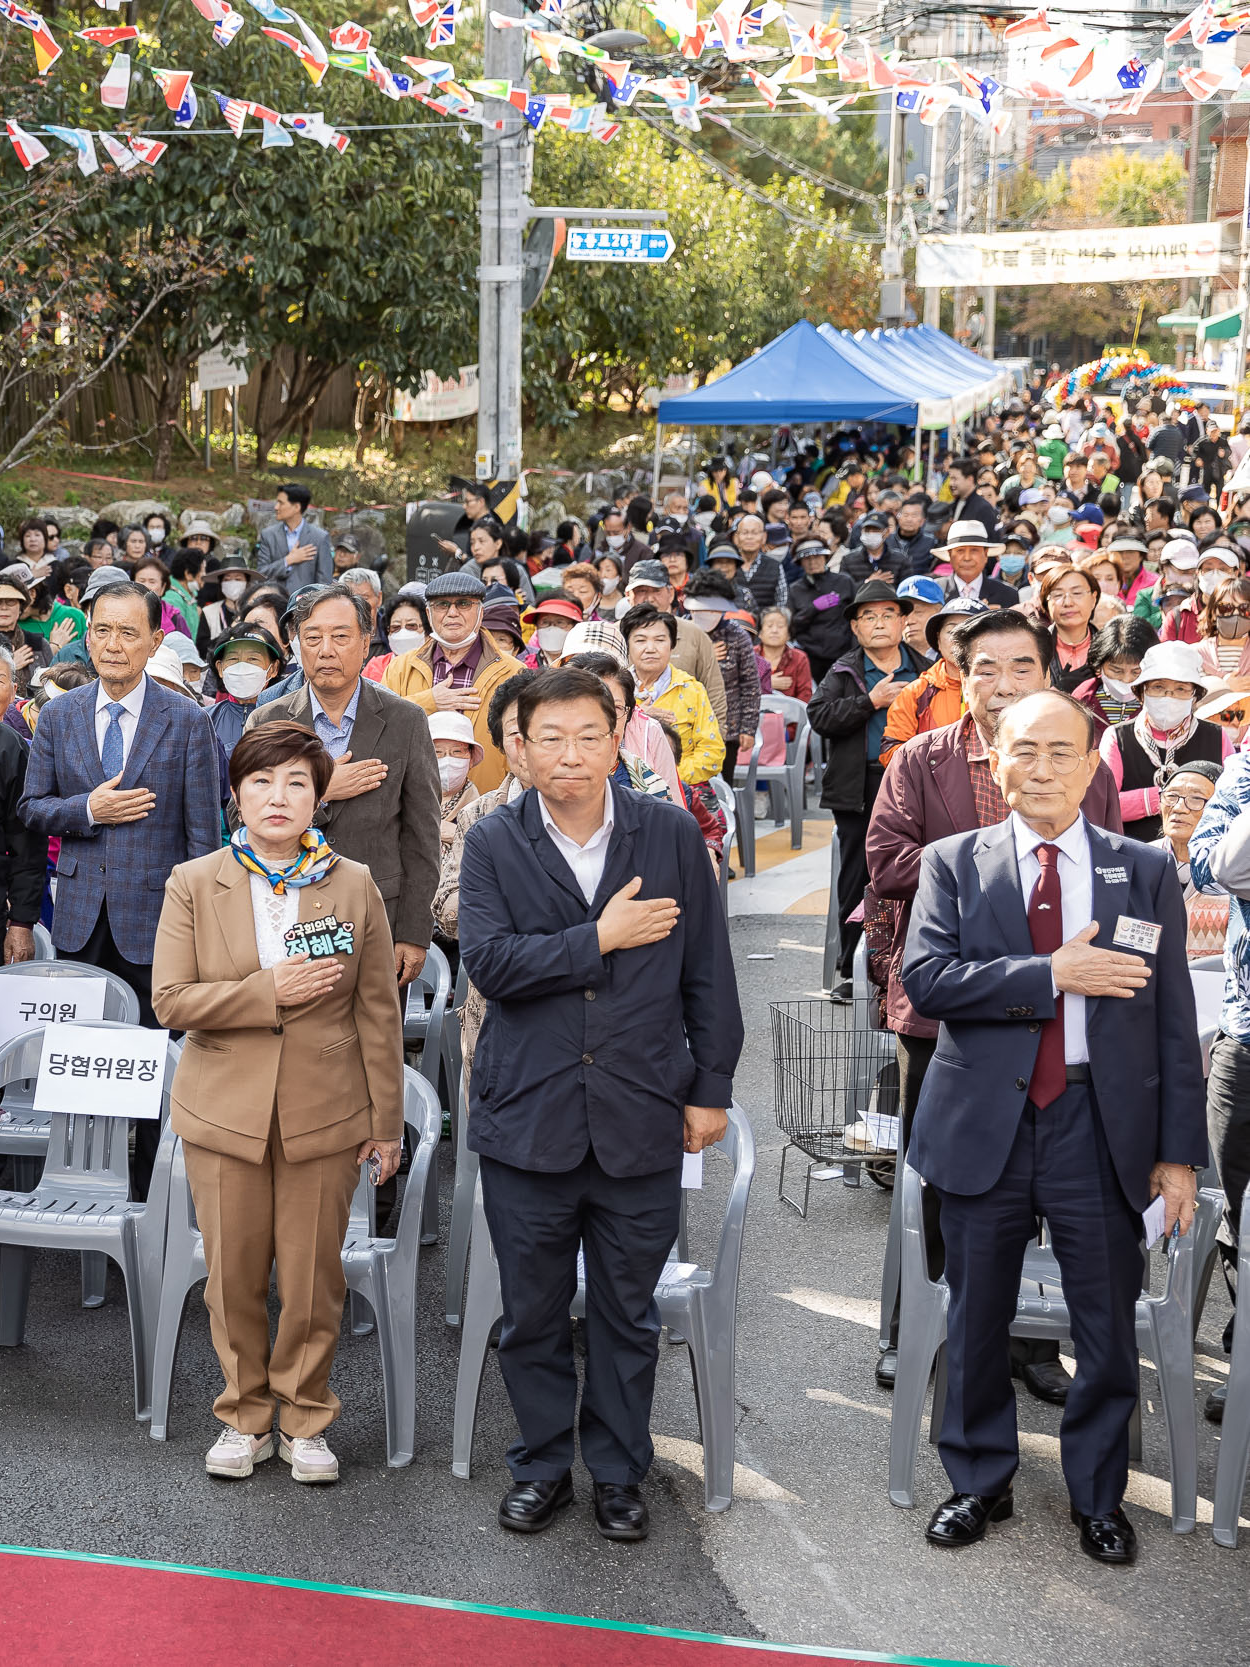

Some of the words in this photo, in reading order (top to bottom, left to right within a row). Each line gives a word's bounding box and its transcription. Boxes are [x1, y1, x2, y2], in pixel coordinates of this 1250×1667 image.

[293, 915, 338, 938] 국회의원
[18, 1002, 77, 1023] 구의원
[48, 1053, 159, 1081] 당협위원장
